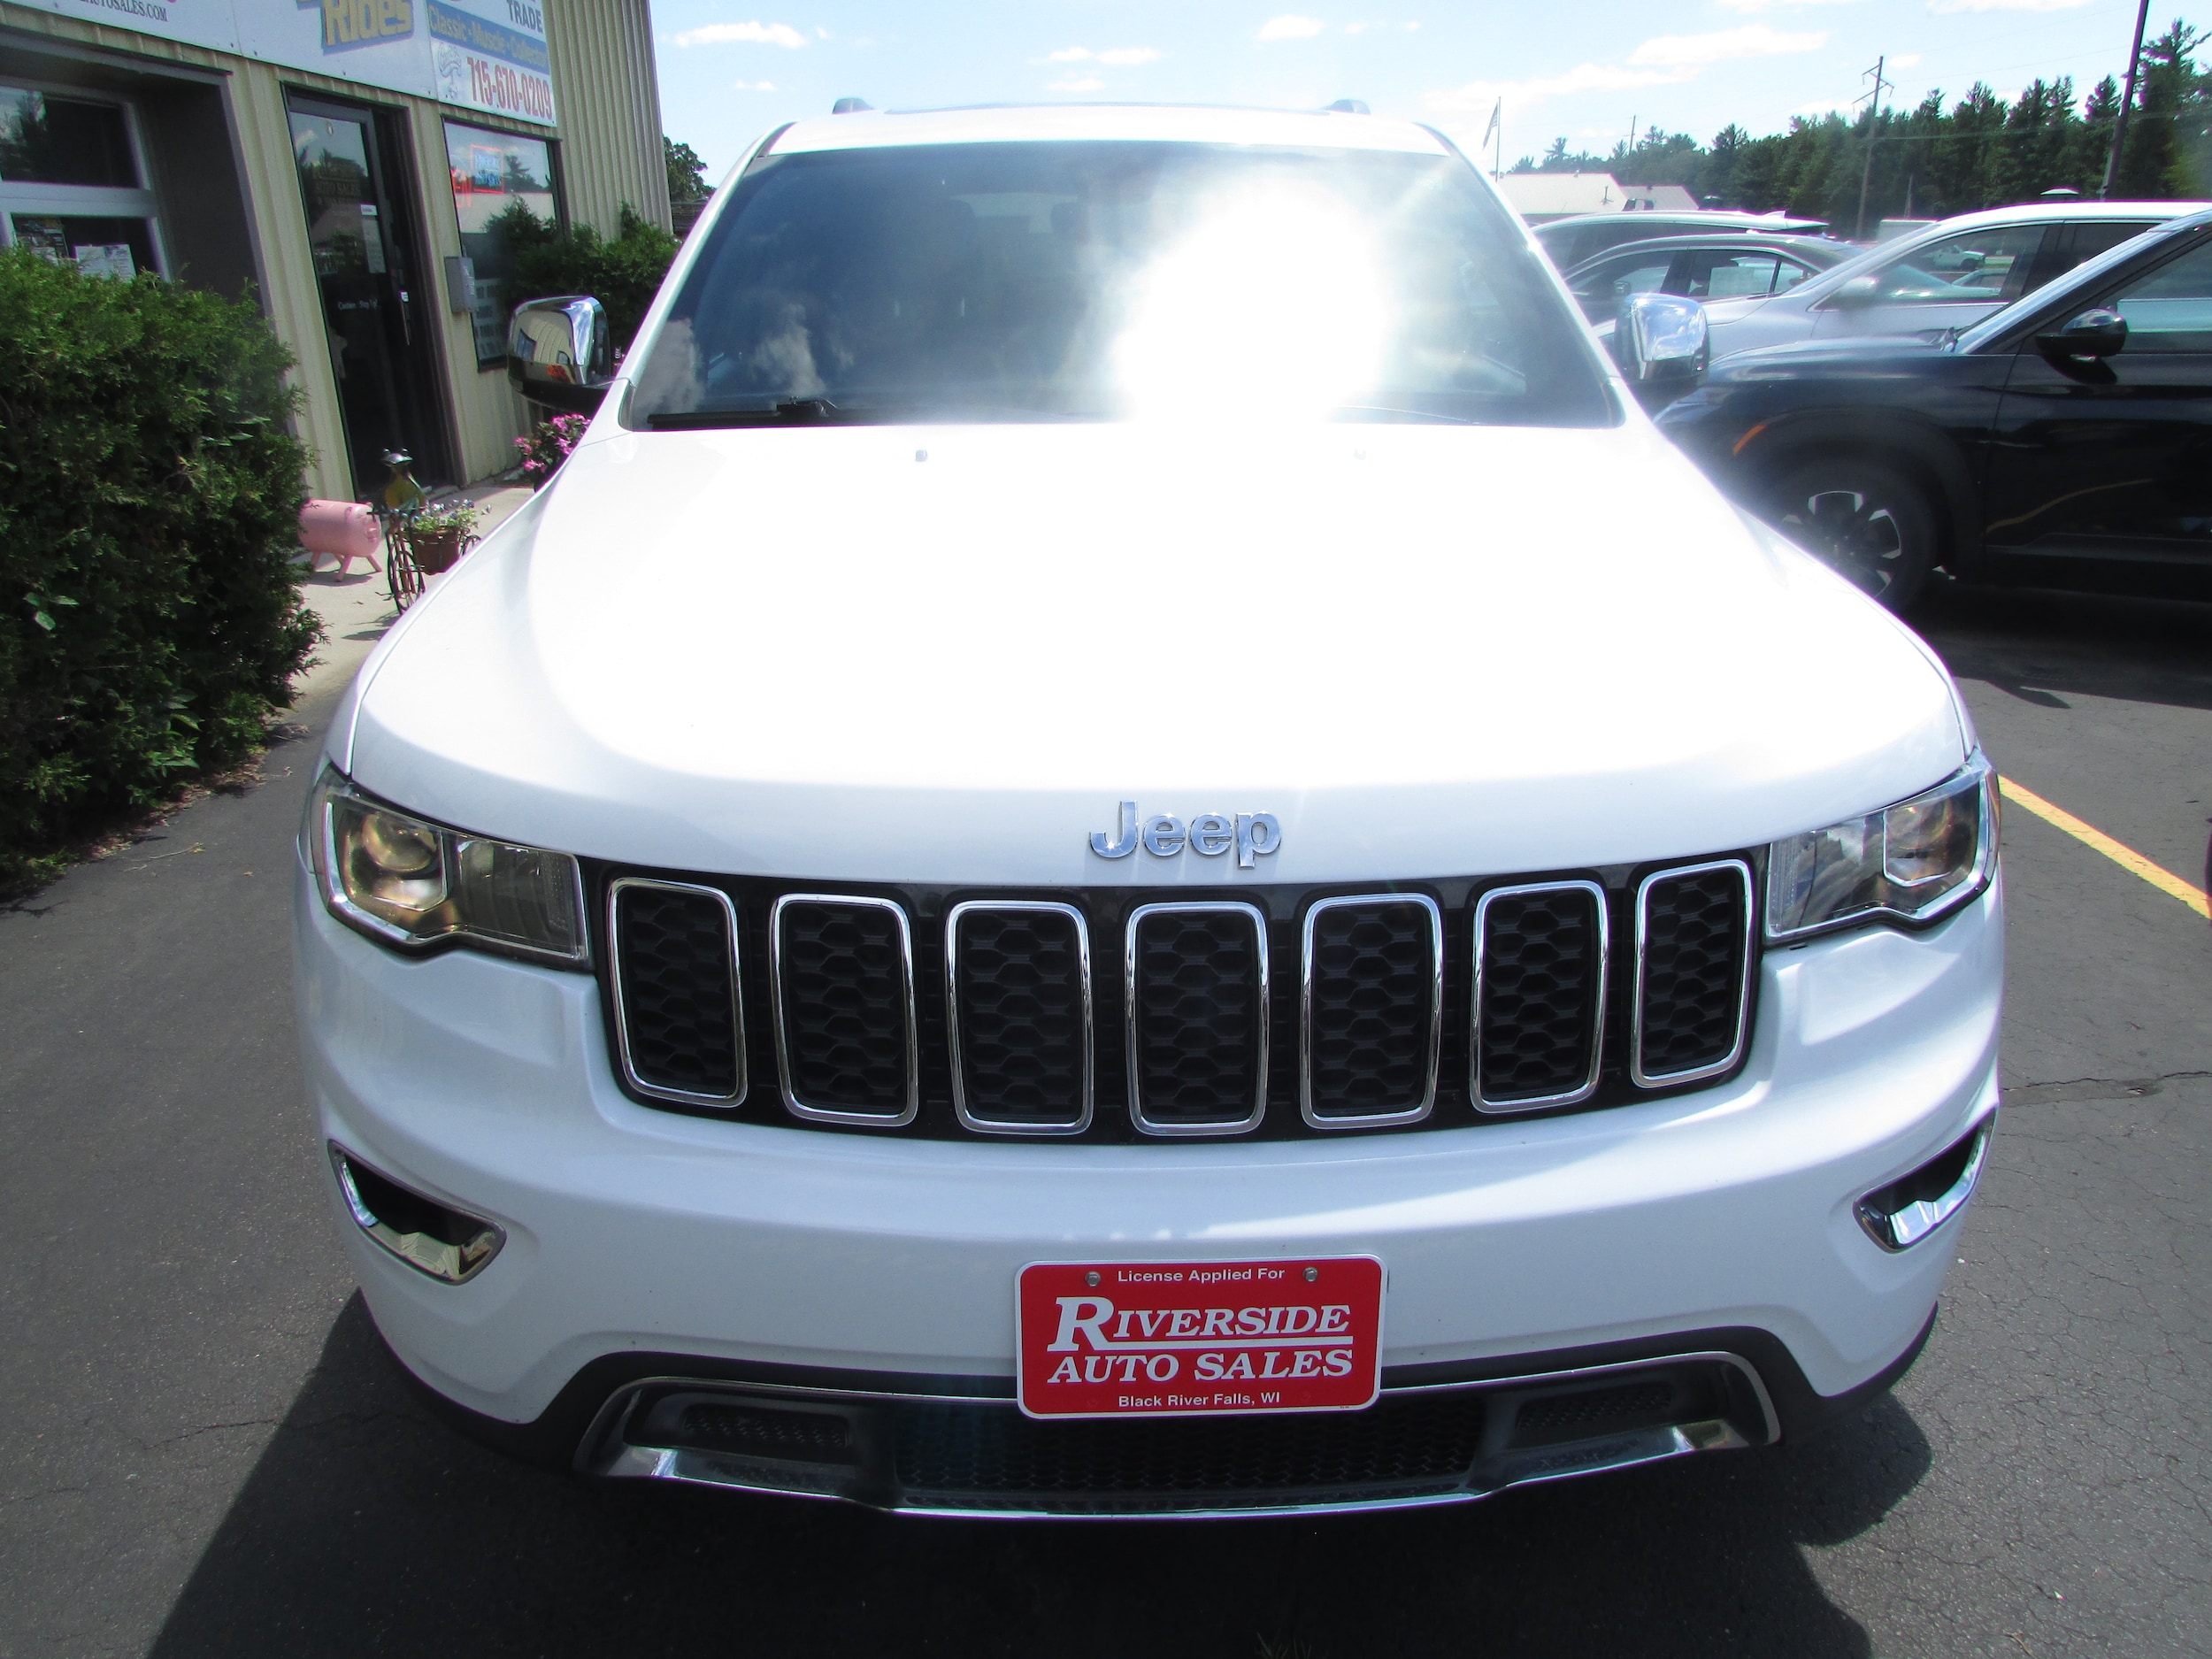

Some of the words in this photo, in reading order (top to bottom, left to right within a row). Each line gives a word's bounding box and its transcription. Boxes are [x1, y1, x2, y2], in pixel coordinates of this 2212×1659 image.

[428, 4, 468, 42] Classic
[507, 0, 543, 34] TRADE
[467, 57, 552, 120] 715-670-0209
[1088, 799, 1281, 869] Jeep
[1118, 1270, 1183, 1283] License
[1188, 1268, 1252, 1284] Applied
[1257, 1268, 1286, 1280] For
[1046, 1296, 1351, 1352] RIVERSIDE
[1047, 1354, 1179, 1384] AUTO
[1194, 1349, 1353, 1381] SALES
[1118, 1394, 1164, 1408] Black
[1167, 1394, 1209, 1407] River
[1214, 1393, 1256, 1406] Falls,
[1260, 1392, 1280, 1404] WI
